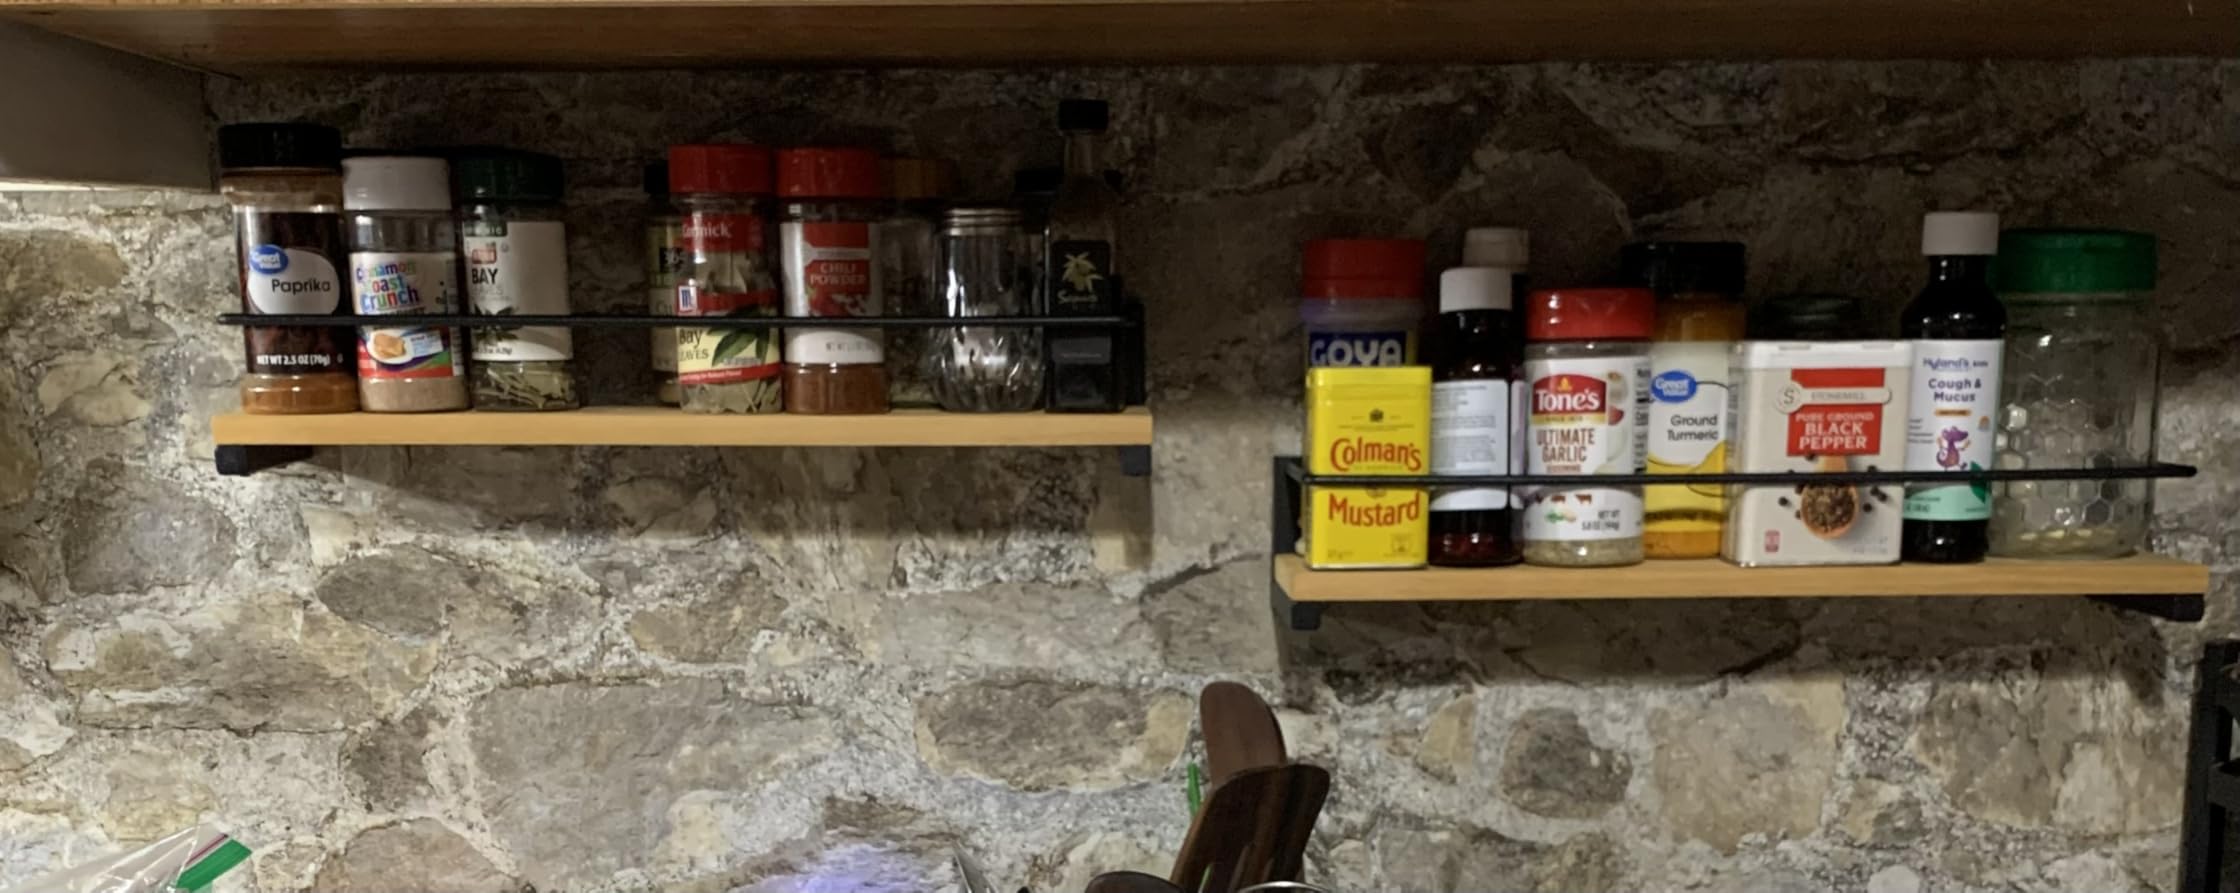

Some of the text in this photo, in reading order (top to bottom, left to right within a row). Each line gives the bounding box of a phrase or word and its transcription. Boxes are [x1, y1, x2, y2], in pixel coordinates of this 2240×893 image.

[820, 263, 857, 273] CHILI
[471, 268, 498, 284] BAY
[810, 275, 865, 285] POWDER
[272, 279, 331, 295] Paprika
[679, 329, 703, 348] Bay
[1311, 339, 1403, 366] GOYA
[298, 355, 309, 365] OZ
[1928, 378, 1982, 391] Cough &
[1536, 388, 1600, 411] Tone's
[1784, 388, 1795, 405] S
[1933, 391, 1977, 403] Mucus
[1670, 414, 1718, 427] Ground
[1827, 412, 1874, 421] GROUND
[1667, 429, 1719, 441] Turmeric
[1804, 422, 1864, 436] BLACK
[1536, 429, 1595, 445] ULTIMATE
[1799, 436, 1868, 450] PEPPER
[1330, 436, 1422, 472] Colman's
[1542, 446, 1588, 461] GARLIC
[1328, 488, 1420, 527] Mustard
